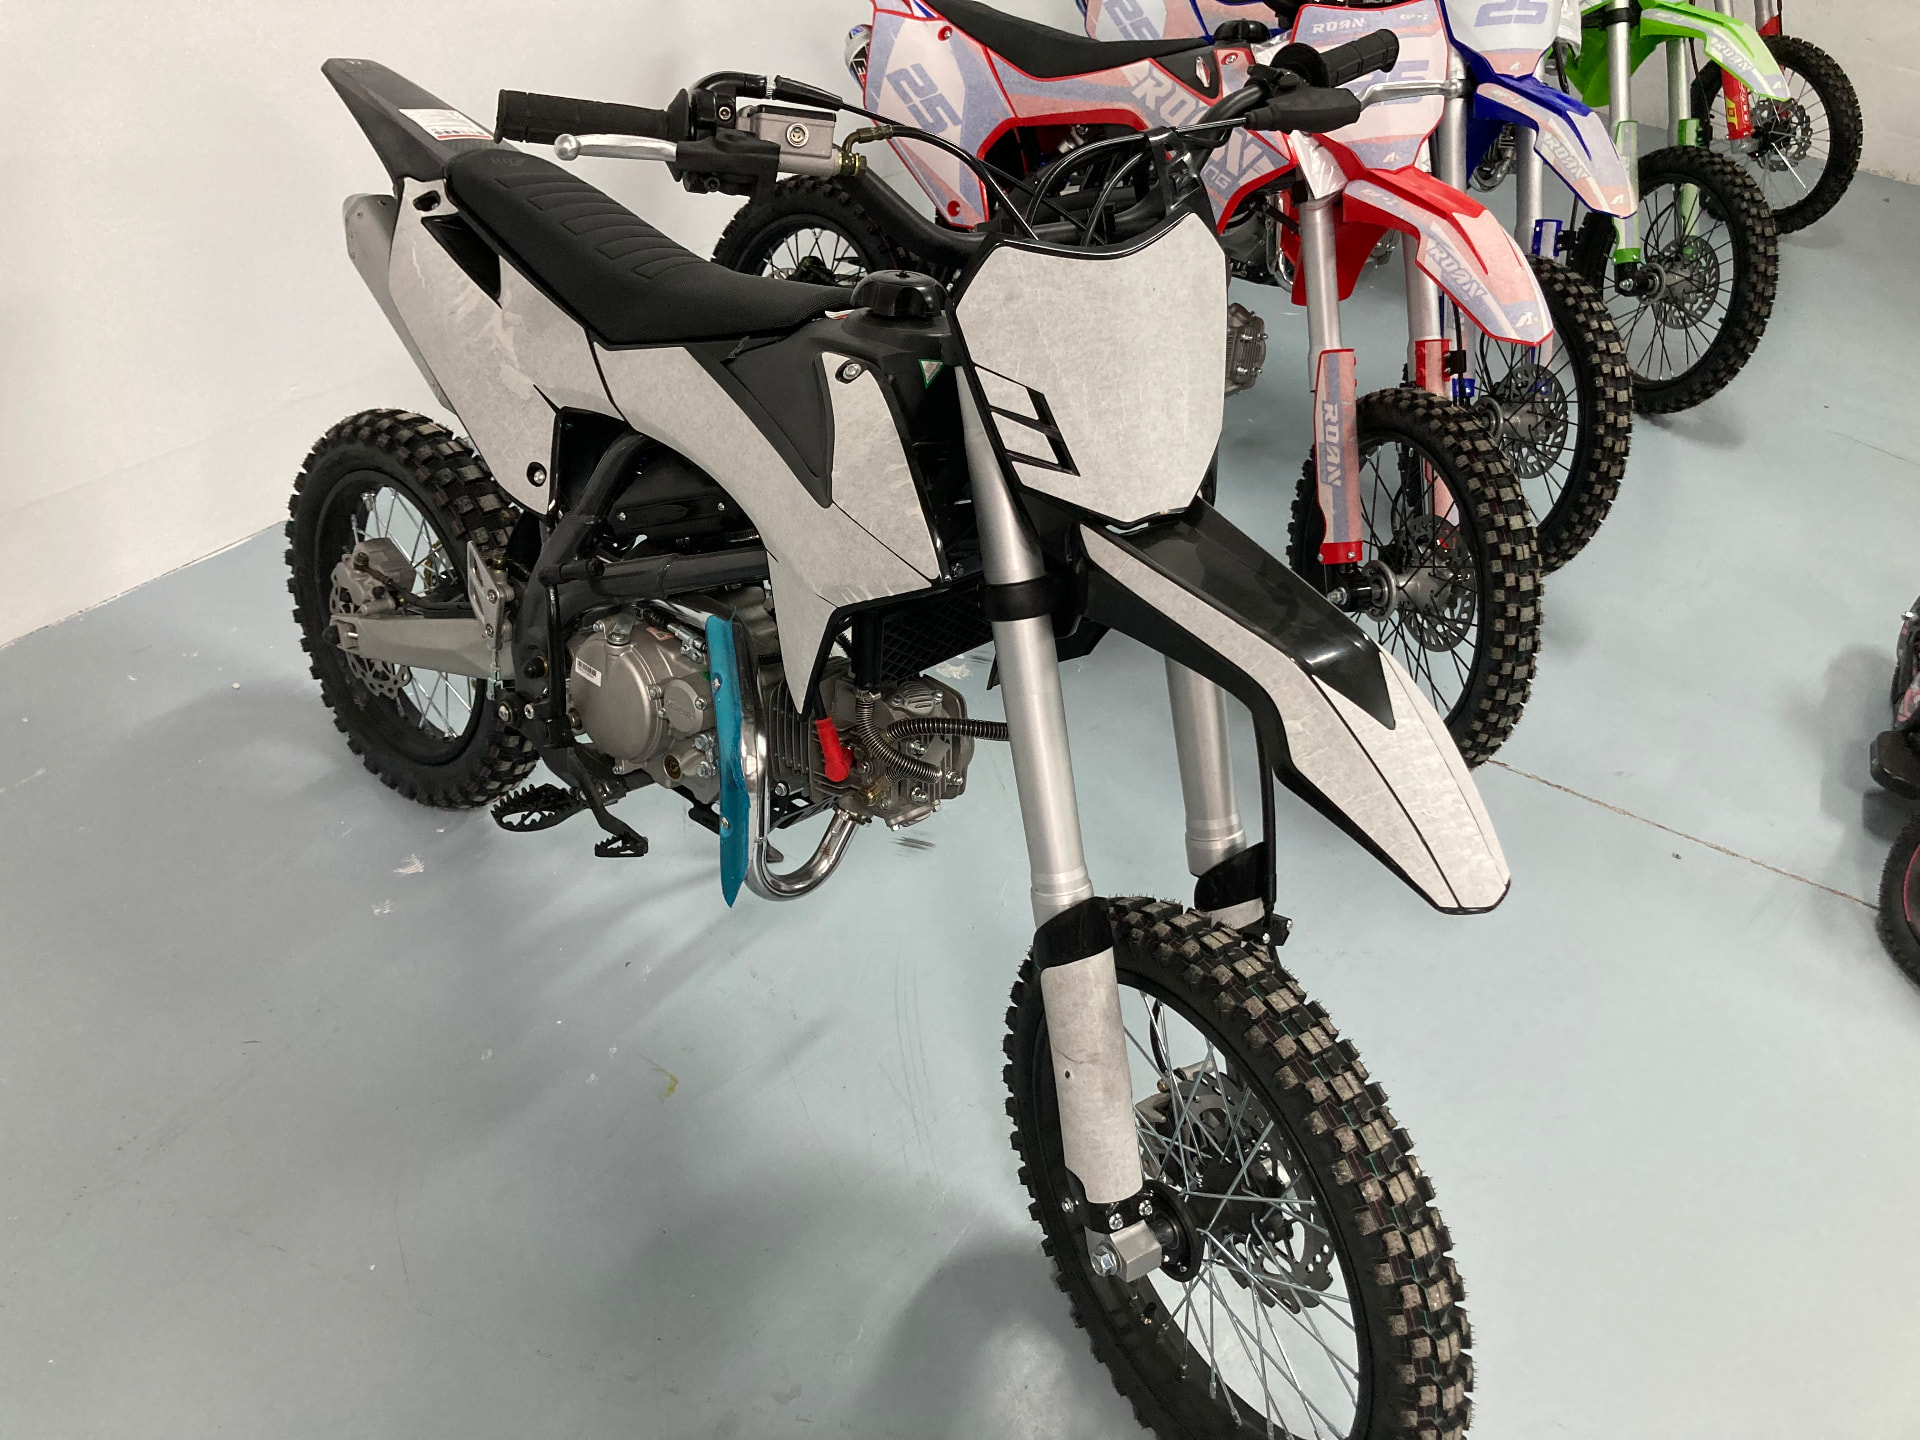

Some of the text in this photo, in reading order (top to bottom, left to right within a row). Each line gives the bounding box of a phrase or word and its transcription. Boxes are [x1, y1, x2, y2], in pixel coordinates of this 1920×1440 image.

[1312, 17, 1366, 34] ROAN
[885, 62, 963, 134] 25
[1544, 135, 1591, 179] ROAN
[1427, 243, 1487, 299] ROAN
[1323, 402, 1342, 488] ROAN
